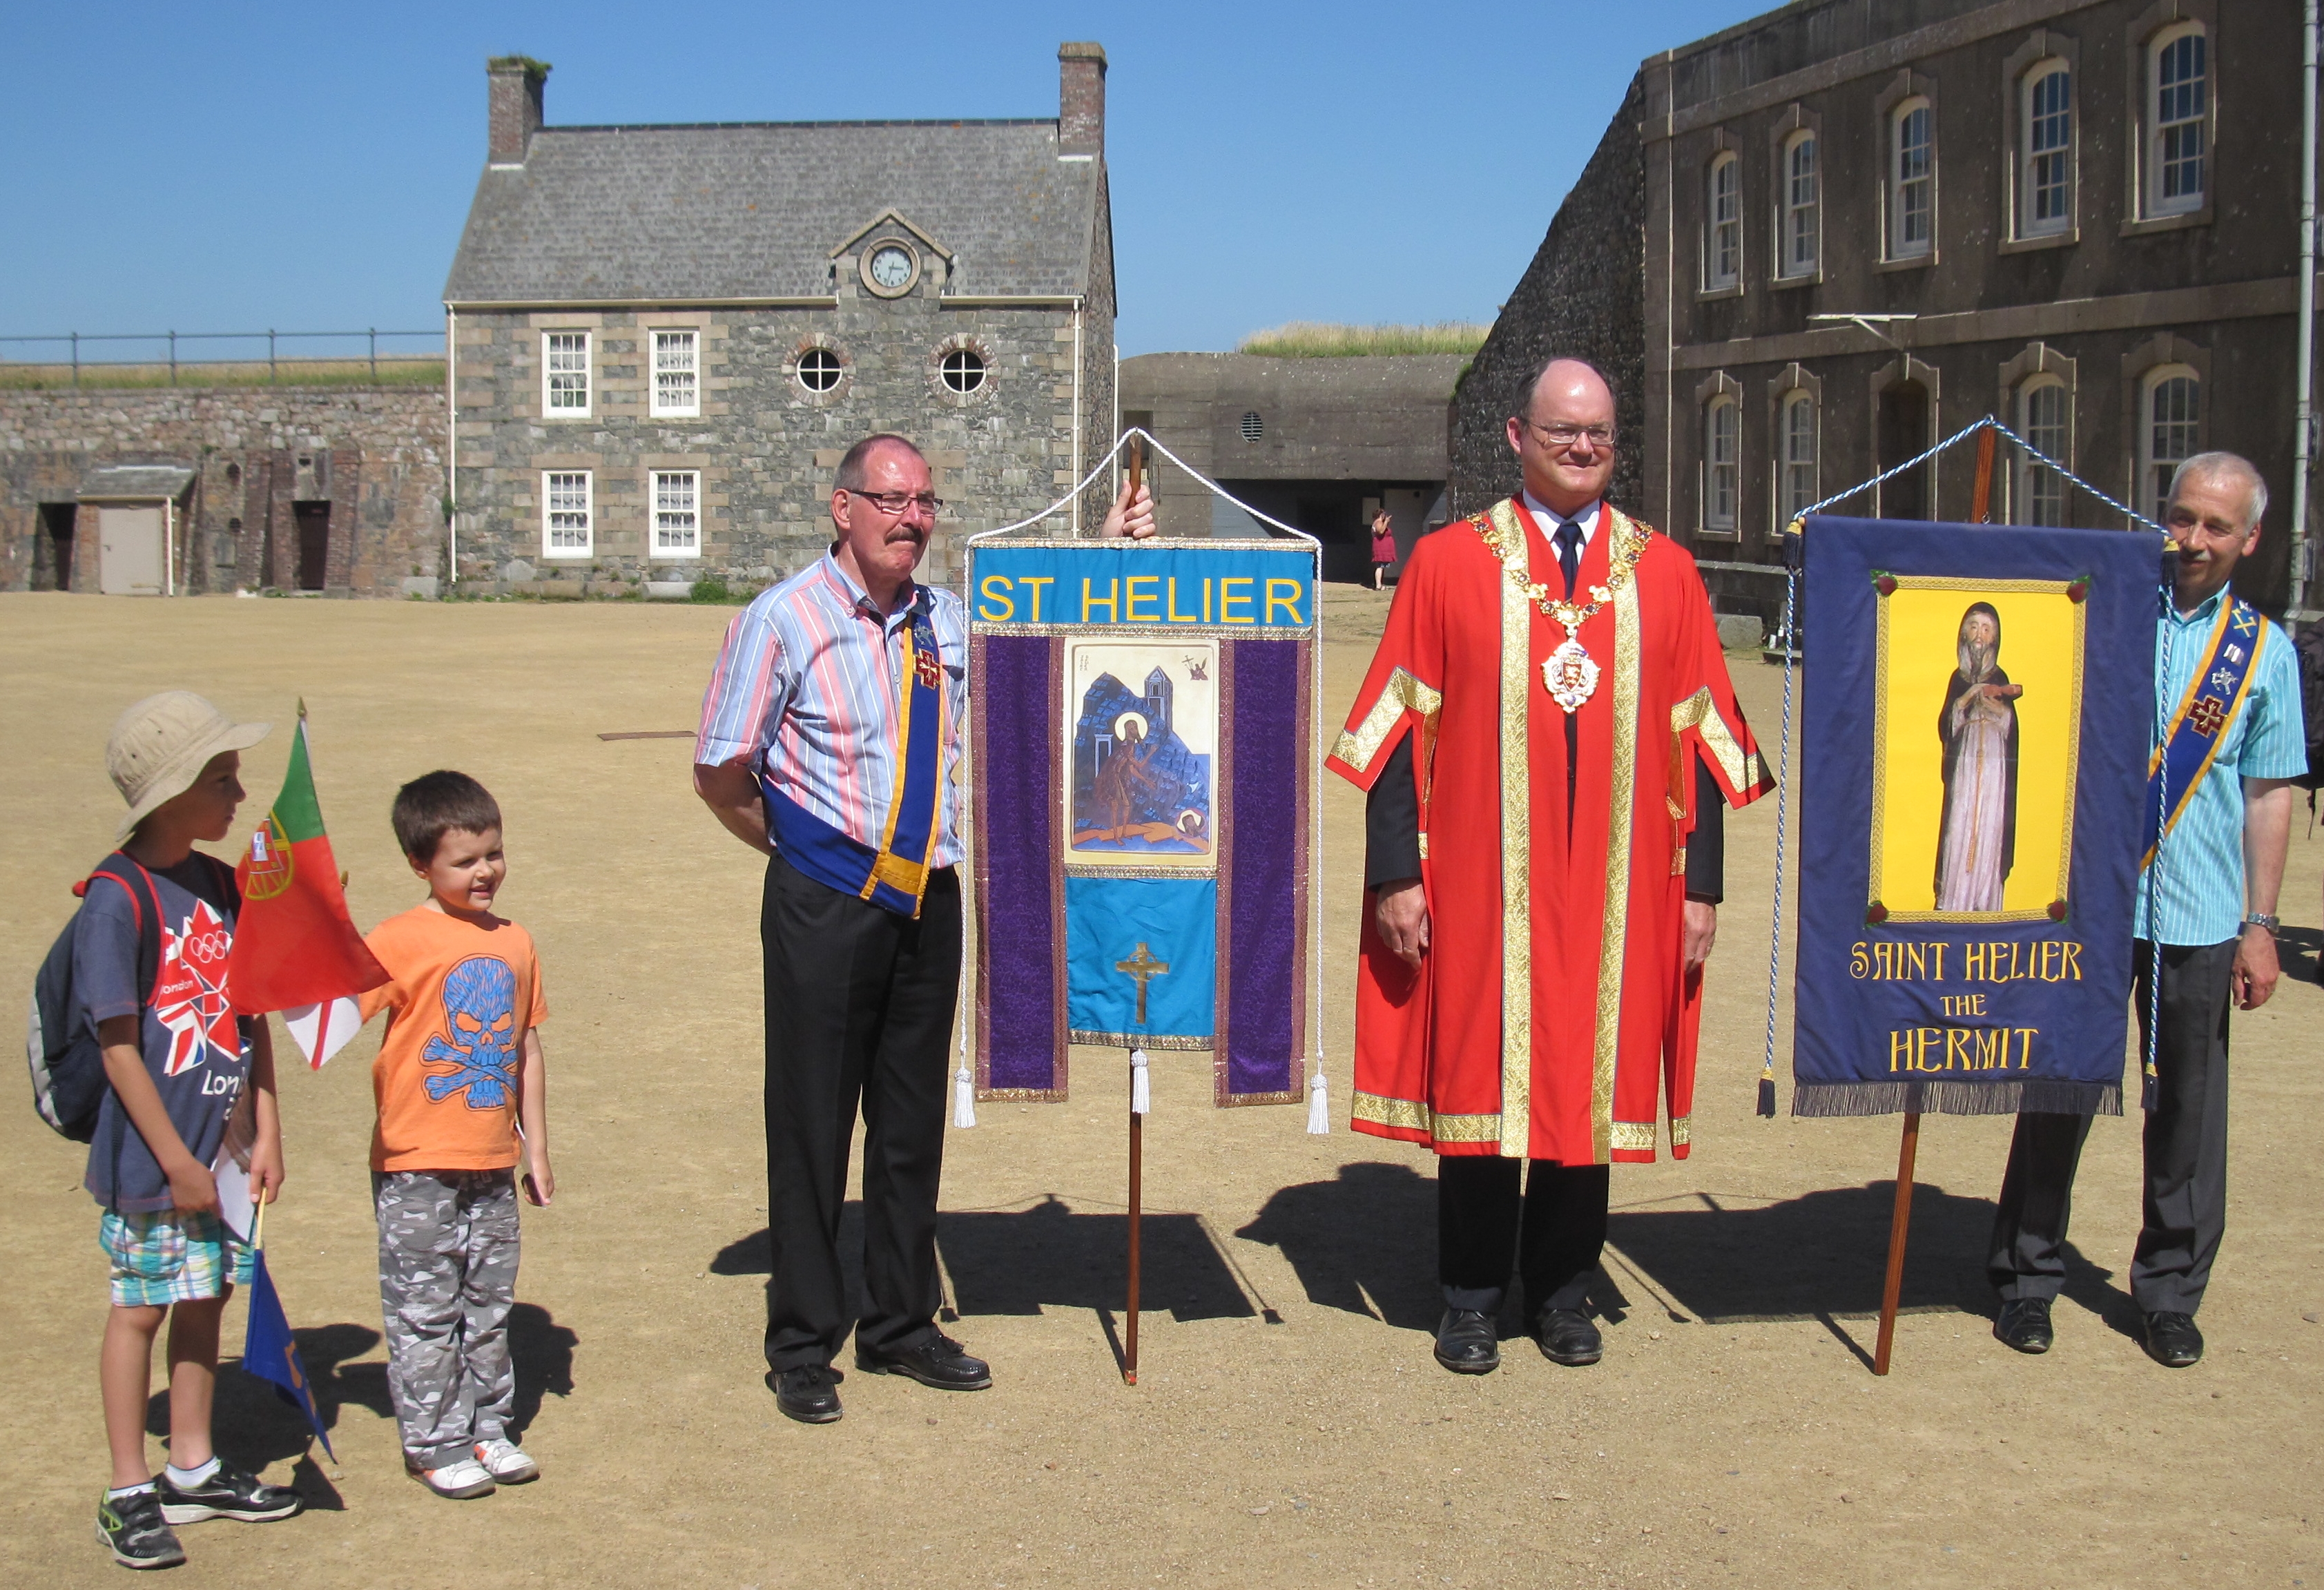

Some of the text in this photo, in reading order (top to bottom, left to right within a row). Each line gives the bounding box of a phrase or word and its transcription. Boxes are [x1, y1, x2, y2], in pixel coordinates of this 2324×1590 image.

[978, 575, 1304, 623] ST HELIER
[1849, 941, 2083, 983] SAINT HELIER
[1939, 994, 1987, 1017] THE
[1889, 1027, 2040, 1073] HERMIT
